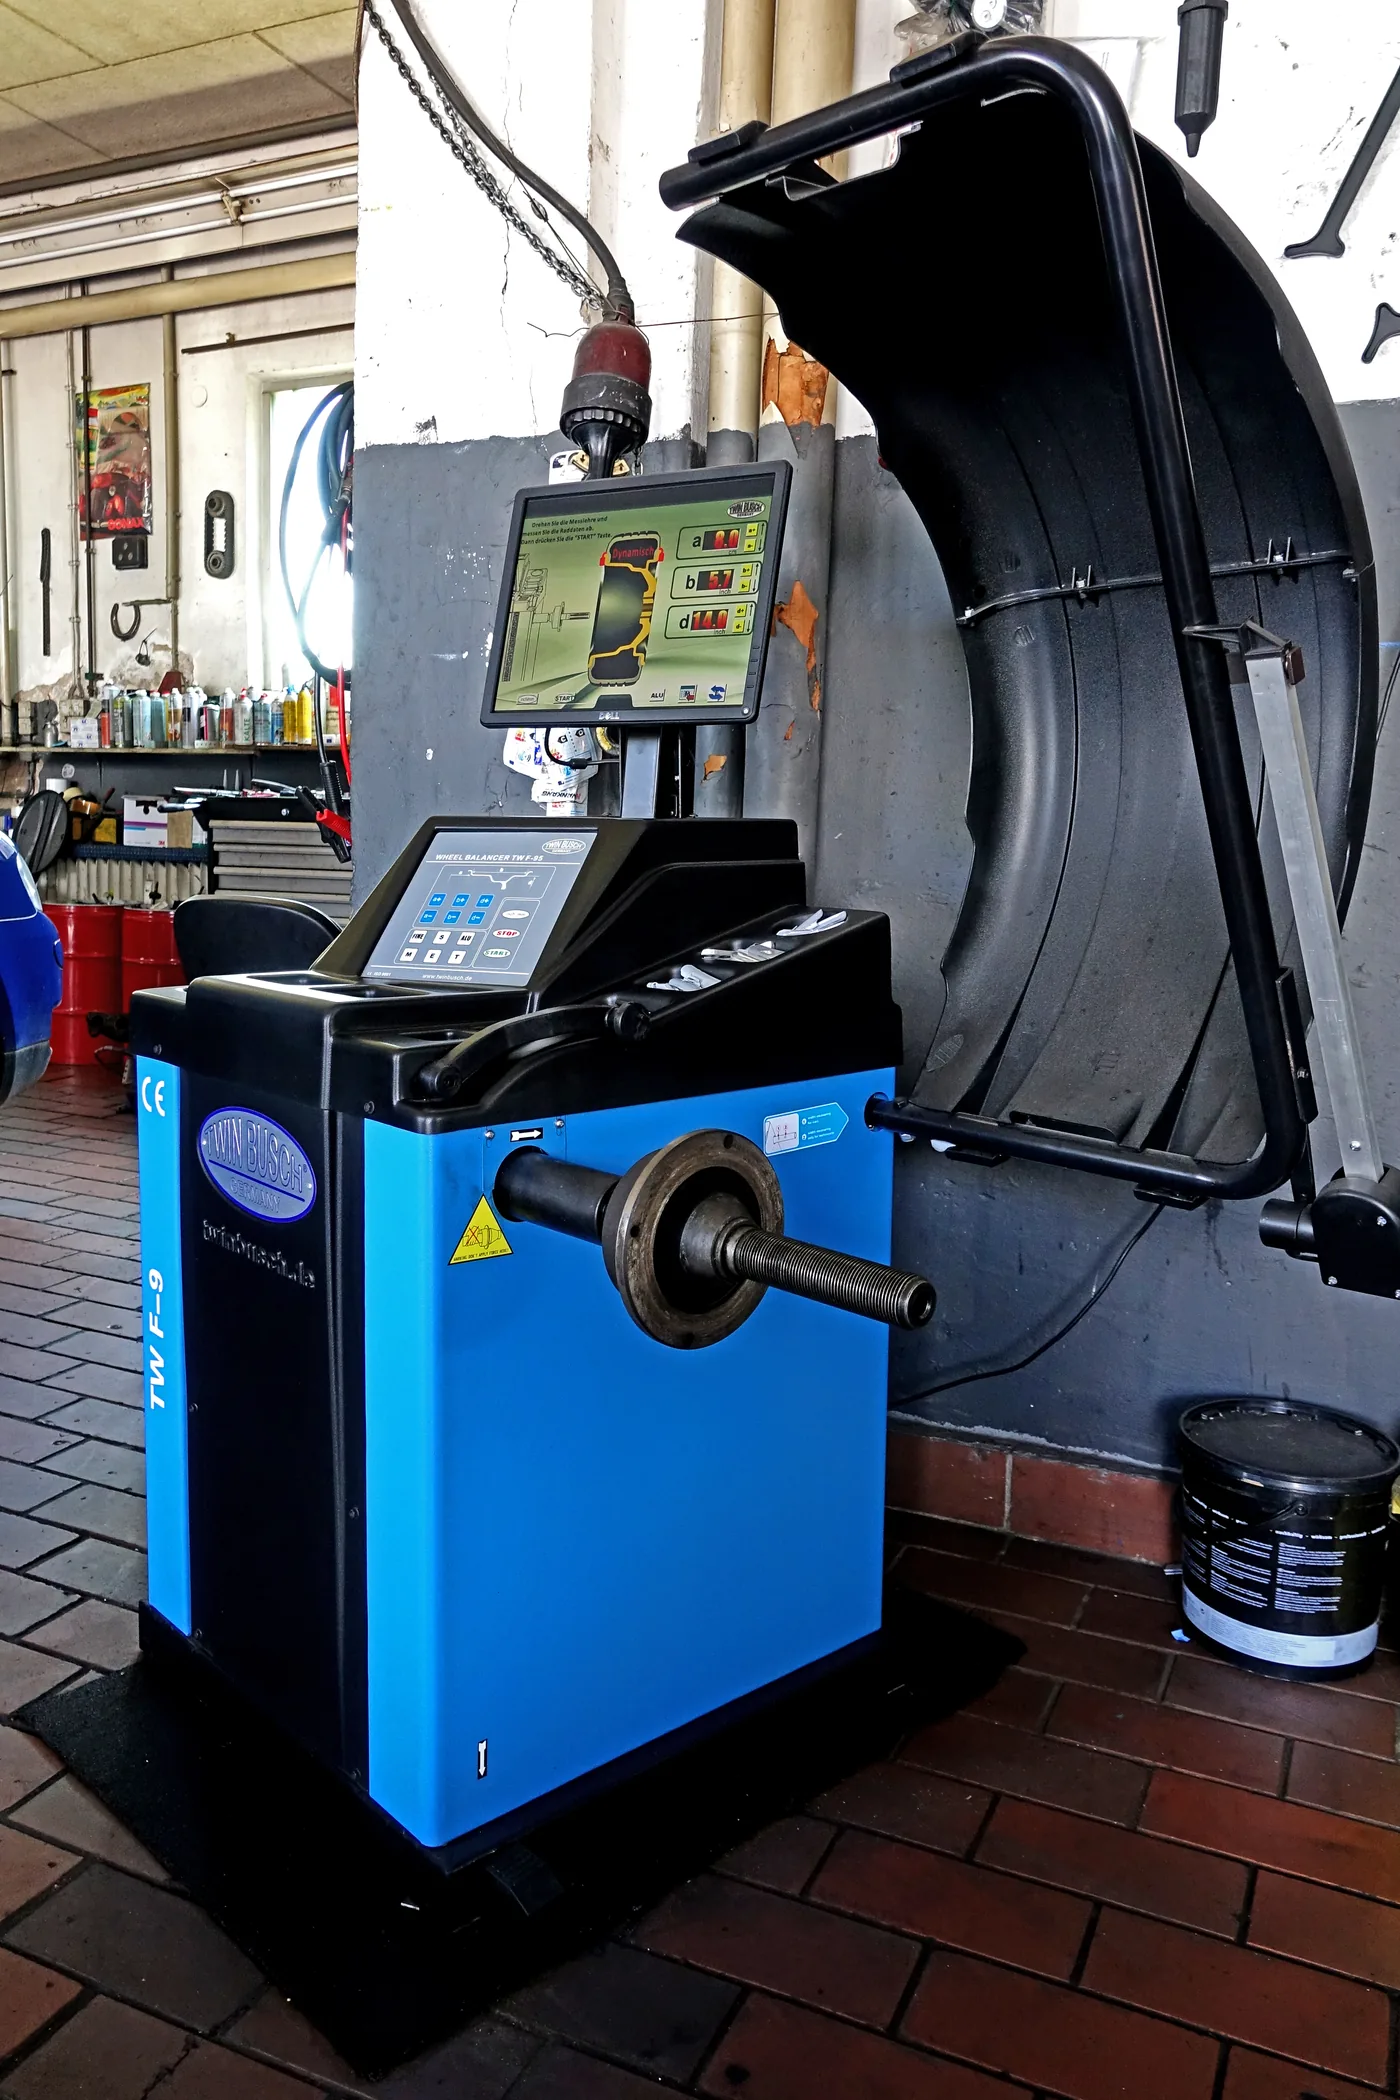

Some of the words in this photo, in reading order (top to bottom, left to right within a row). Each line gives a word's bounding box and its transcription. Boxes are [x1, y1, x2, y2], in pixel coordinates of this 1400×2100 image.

[107, 517, 144, 531] SONAX
[692, 535, 702, 548] a
[612, 545, 655, 560] Dynamisch
[685, 575, 696, 590] b
[708, 570, 732, 590] 5.7
[679, 614, 690, 630] d
[693, 610, 728, 630] 14.0
[599, 711, 620, 720] DELL
[204, 1117, 243, 1169] TWIN
[230, 1177, 280, 1214] GERMANY
[149, 1349, 165, 1410] TW
